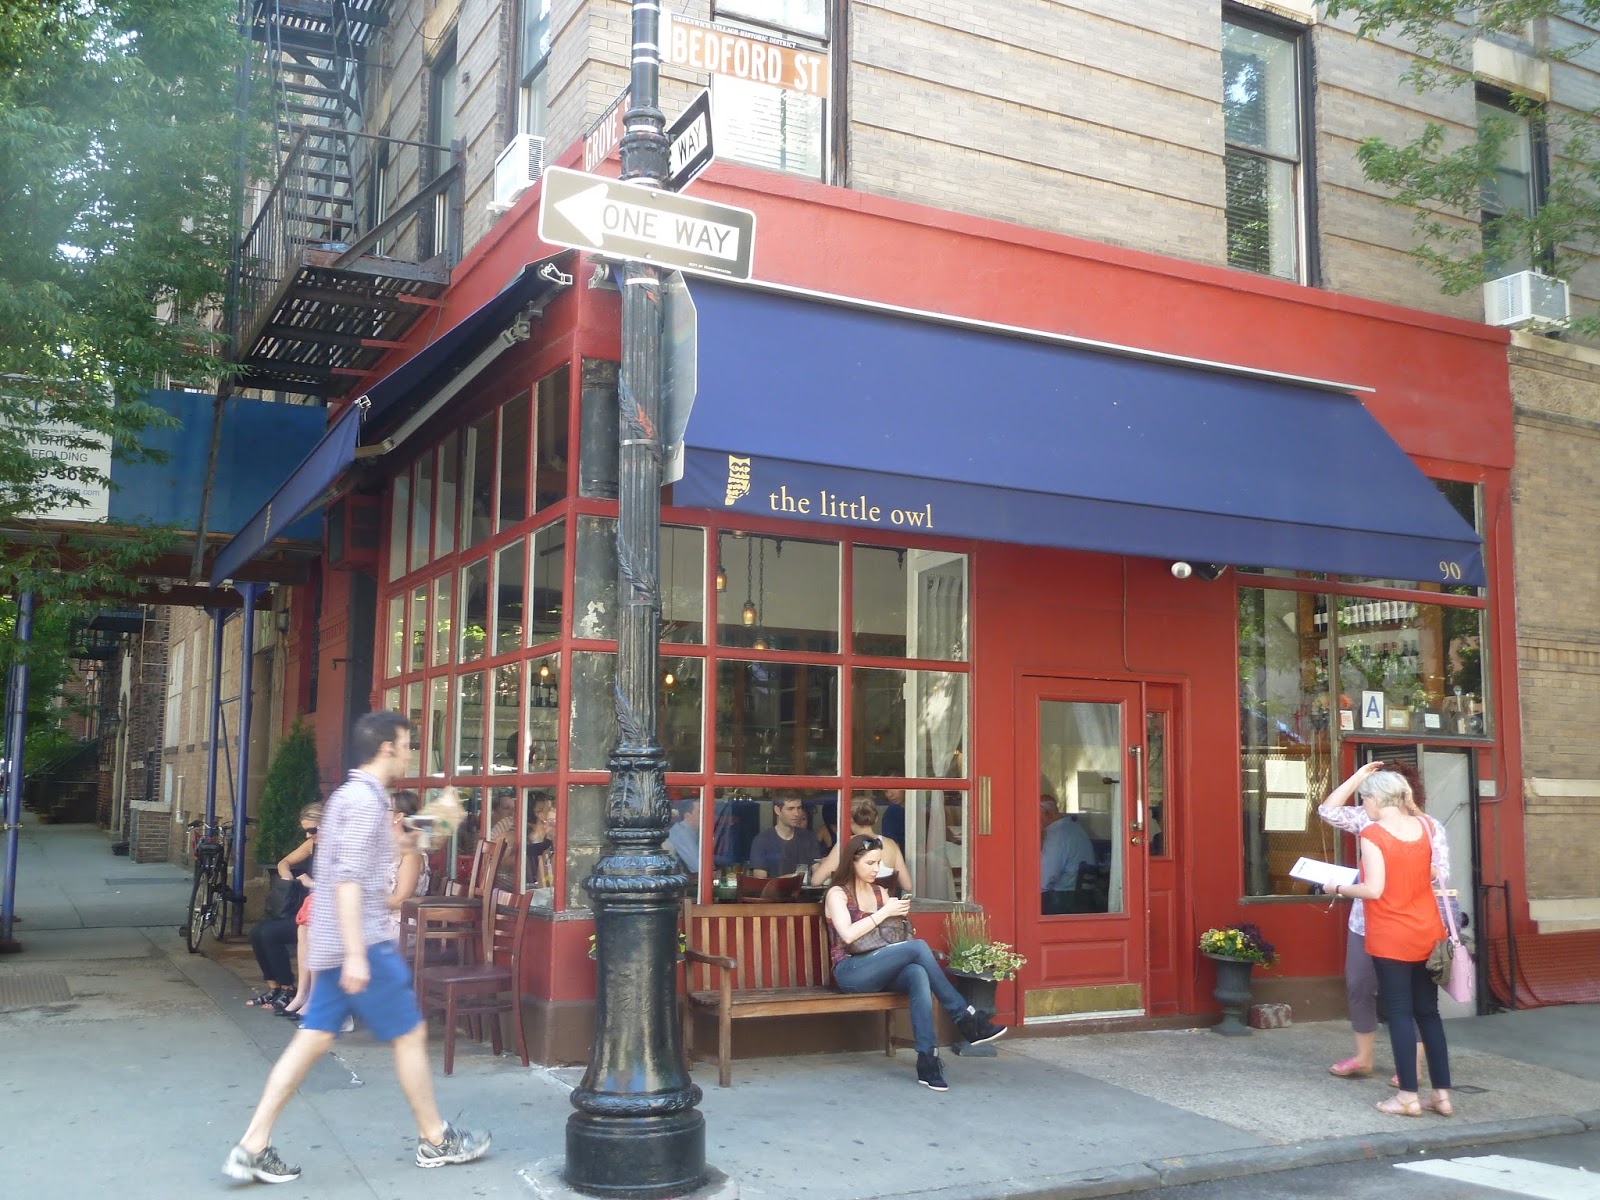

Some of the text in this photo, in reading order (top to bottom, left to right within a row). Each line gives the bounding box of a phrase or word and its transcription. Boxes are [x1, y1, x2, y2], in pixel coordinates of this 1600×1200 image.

[672, 26, 821, 93] BEDFORD ST
[585, 107, 619, 173] GROVE
[678, 120, 702, 166] WAY
[603, 204, 732, 254] ONE WAY
[769, 485, 933, 528] the little owl
[1439, 560, 1461, 580] 90
[1366, 695, 1381, 719] A
